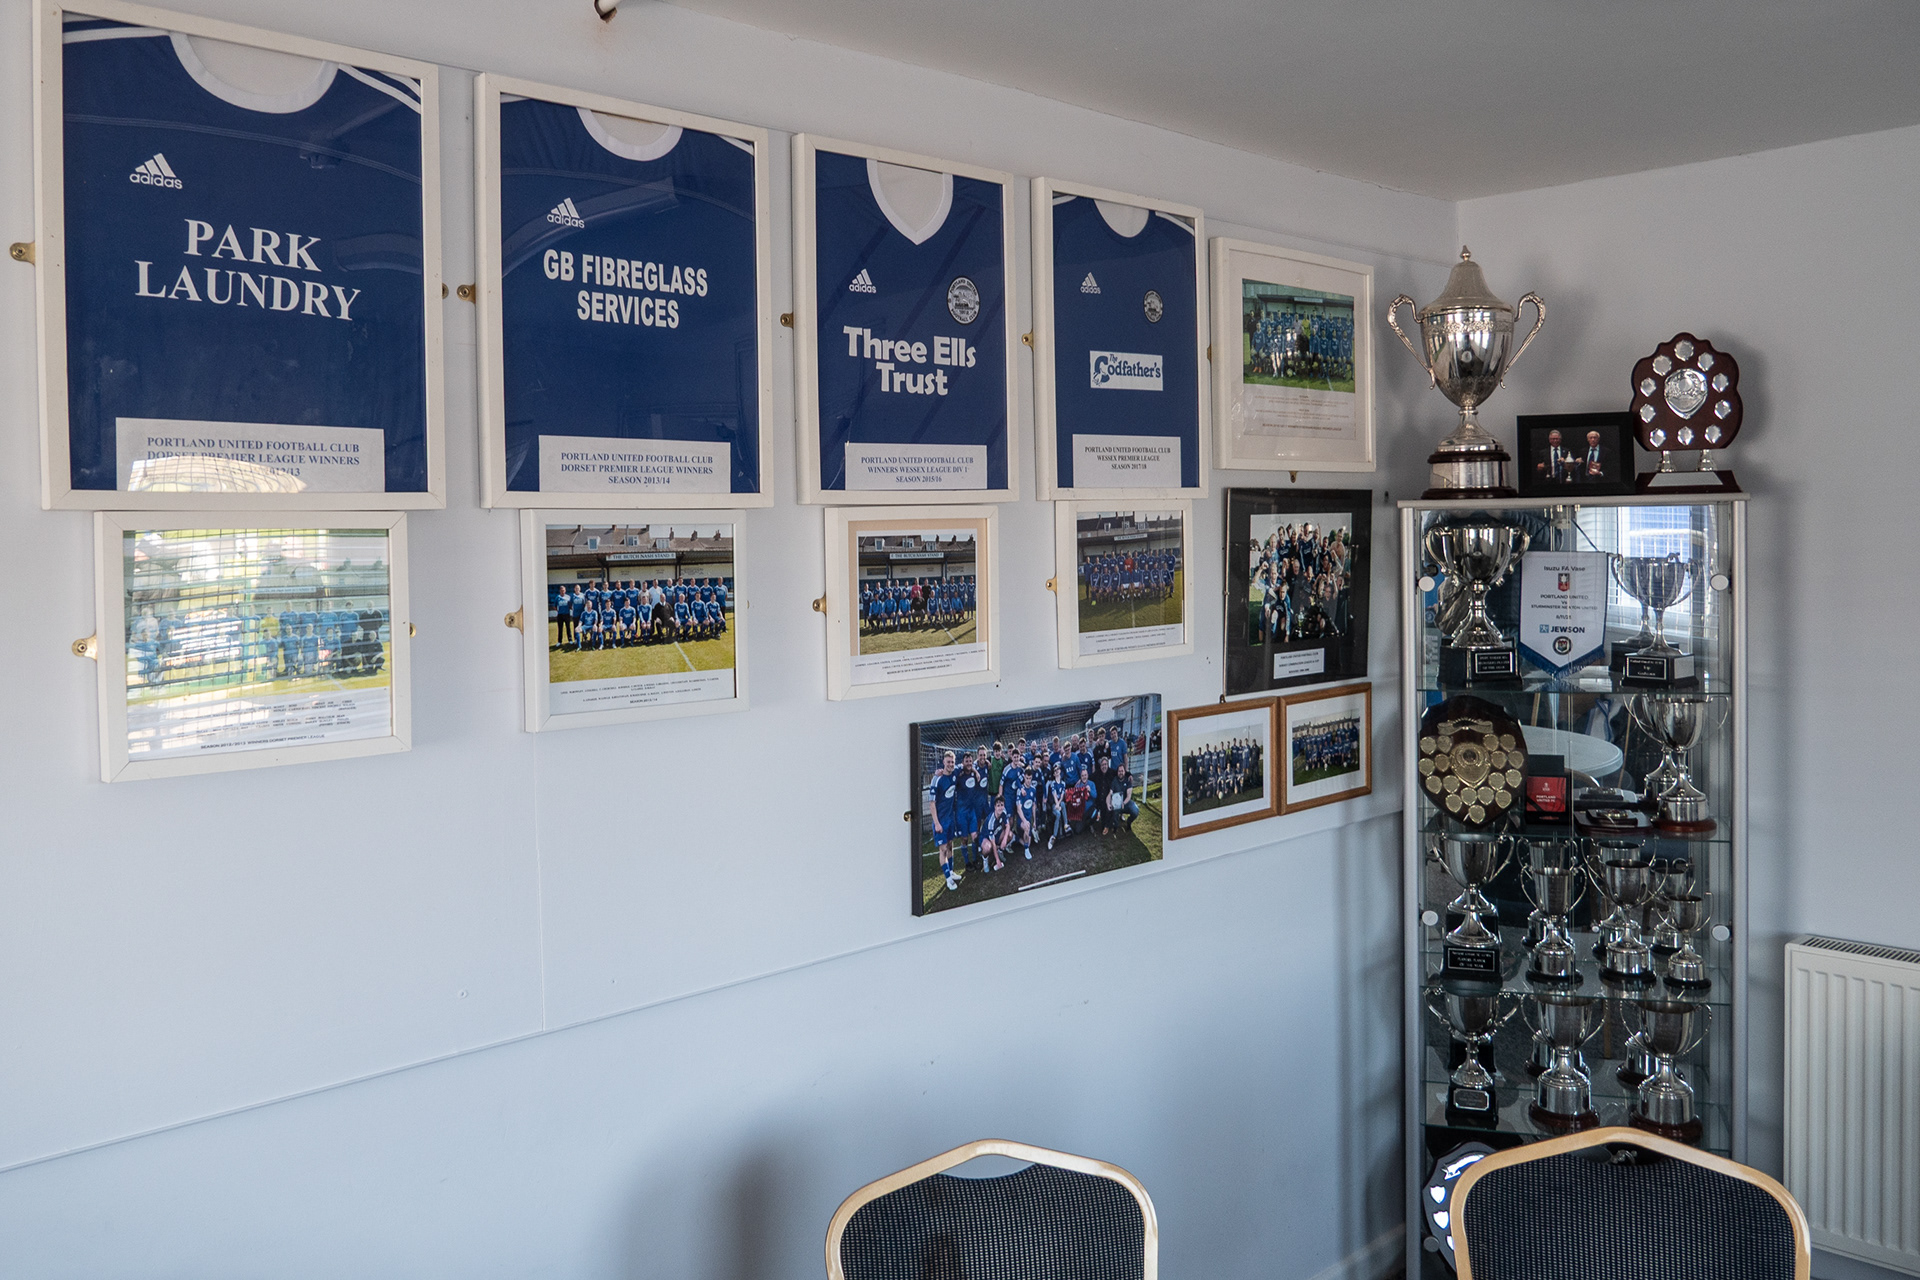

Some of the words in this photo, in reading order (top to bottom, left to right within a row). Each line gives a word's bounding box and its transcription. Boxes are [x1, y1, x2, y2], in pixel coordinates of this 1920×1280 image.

[129, 172, 183, 190] adidas
[547, 213, 585, 229] adidas
[184, 218, 322, 272] PARK
[543, 249, 575, 282] GB
[582, 254, 708, 297] FIBREGLASS
[134, 260, 361, 321] LAUNDRY
[849, 284, 877, 294] adidas
[1080, 286, 1101, 295] adidas
[576, 290, 680, 329] SERVICES
[843, 325, 928, 364] Three
[933, 335, 977, 369] Ells
[875, 361, 949, 396] Trust
[147, 437, 215, 449] PORTLAND
[218, 438, 263, 451] UNITED
[266, 440, 328, 453] FOOTBALL
[330, 442, 360, 454] CLUB
[1112, 446, 1132, 454] UNITED
[1132, 446, 1158, 454] FOOTBALL
[258, 453, 306, 465] LEAGUE
[308, 454, 360, 466] WINNERS
[561, 452, 609, 462] PORTLAND
[611, 453, 643, 463] UNITED
[645, 454, 690, 464] FOOTBALL
[691, 455, 713, 464] CLUB
[861, 456, 898, 464] PORTLAND
[899, 456, 922, 464] UNITED
[923, 456, 956, 464] FOOTBALL
[957, 456, 974, 464] CLUB
[561, 464, 596, 473] DORSET
[599, 464, 638, 474] PREMIER
[640, 465, 674, 475] LEAGUE
[676, 466, 713, 475] WINNERS
[867, 466, 898, 474] WINNERS
[899, 466, 926, 474] WESSEX
[926, 466, 952, 474] LEAGUE
[952, 466, 964, 474] DIV
[608, 476, 642, 485] SEASON
[644, 476, 670, 485] 2013/14
[896, 475, 921, 483] SEASON
[922, 475, 942, 484] 2015/16
